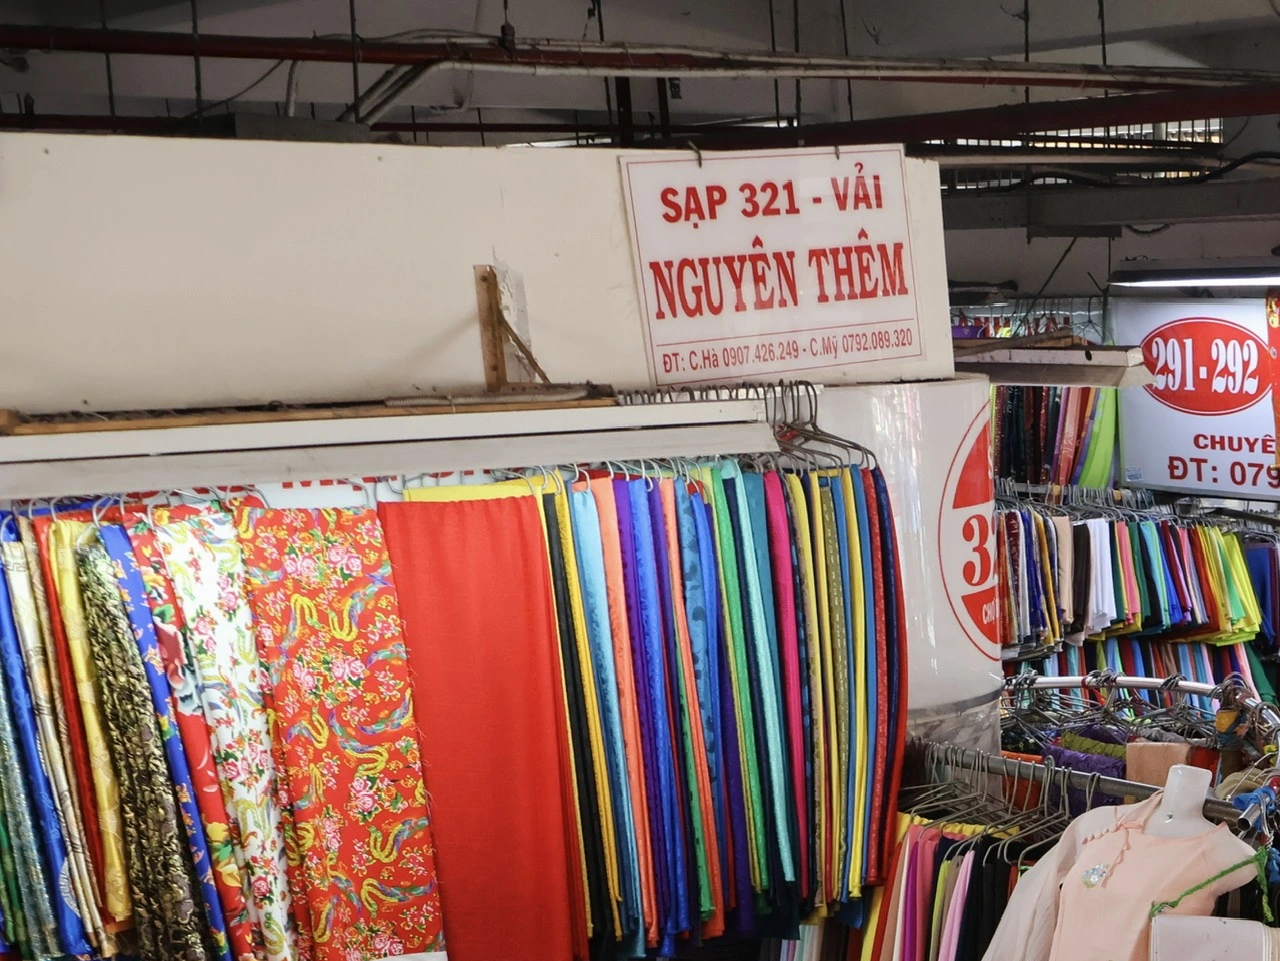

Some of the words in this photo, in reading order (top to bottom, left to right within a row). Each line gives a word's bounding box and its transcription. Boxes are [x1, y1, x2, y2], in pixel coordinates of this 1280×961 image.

[660, 185, 727, 229] SẠP
[738, 180, 800, 218] 321
[831, 162, 884, 212] VẢI
[649, 235, 798, 320] NGUYÊN
[808, 227, 909, 303] THÊM
[663, 353, 686, 374] ĐT:
[689, 349, 719, 370] C.Hà
[722, 341, 799, 368] 0907.426.249
[809, 336, 838, 360] C.Mỹ
[841, 328, 913, 353] 0792.089.320
[1193, 434, 1275, 454] CHUYÊ
[1168, 456, 1218, 483] ĐT:
